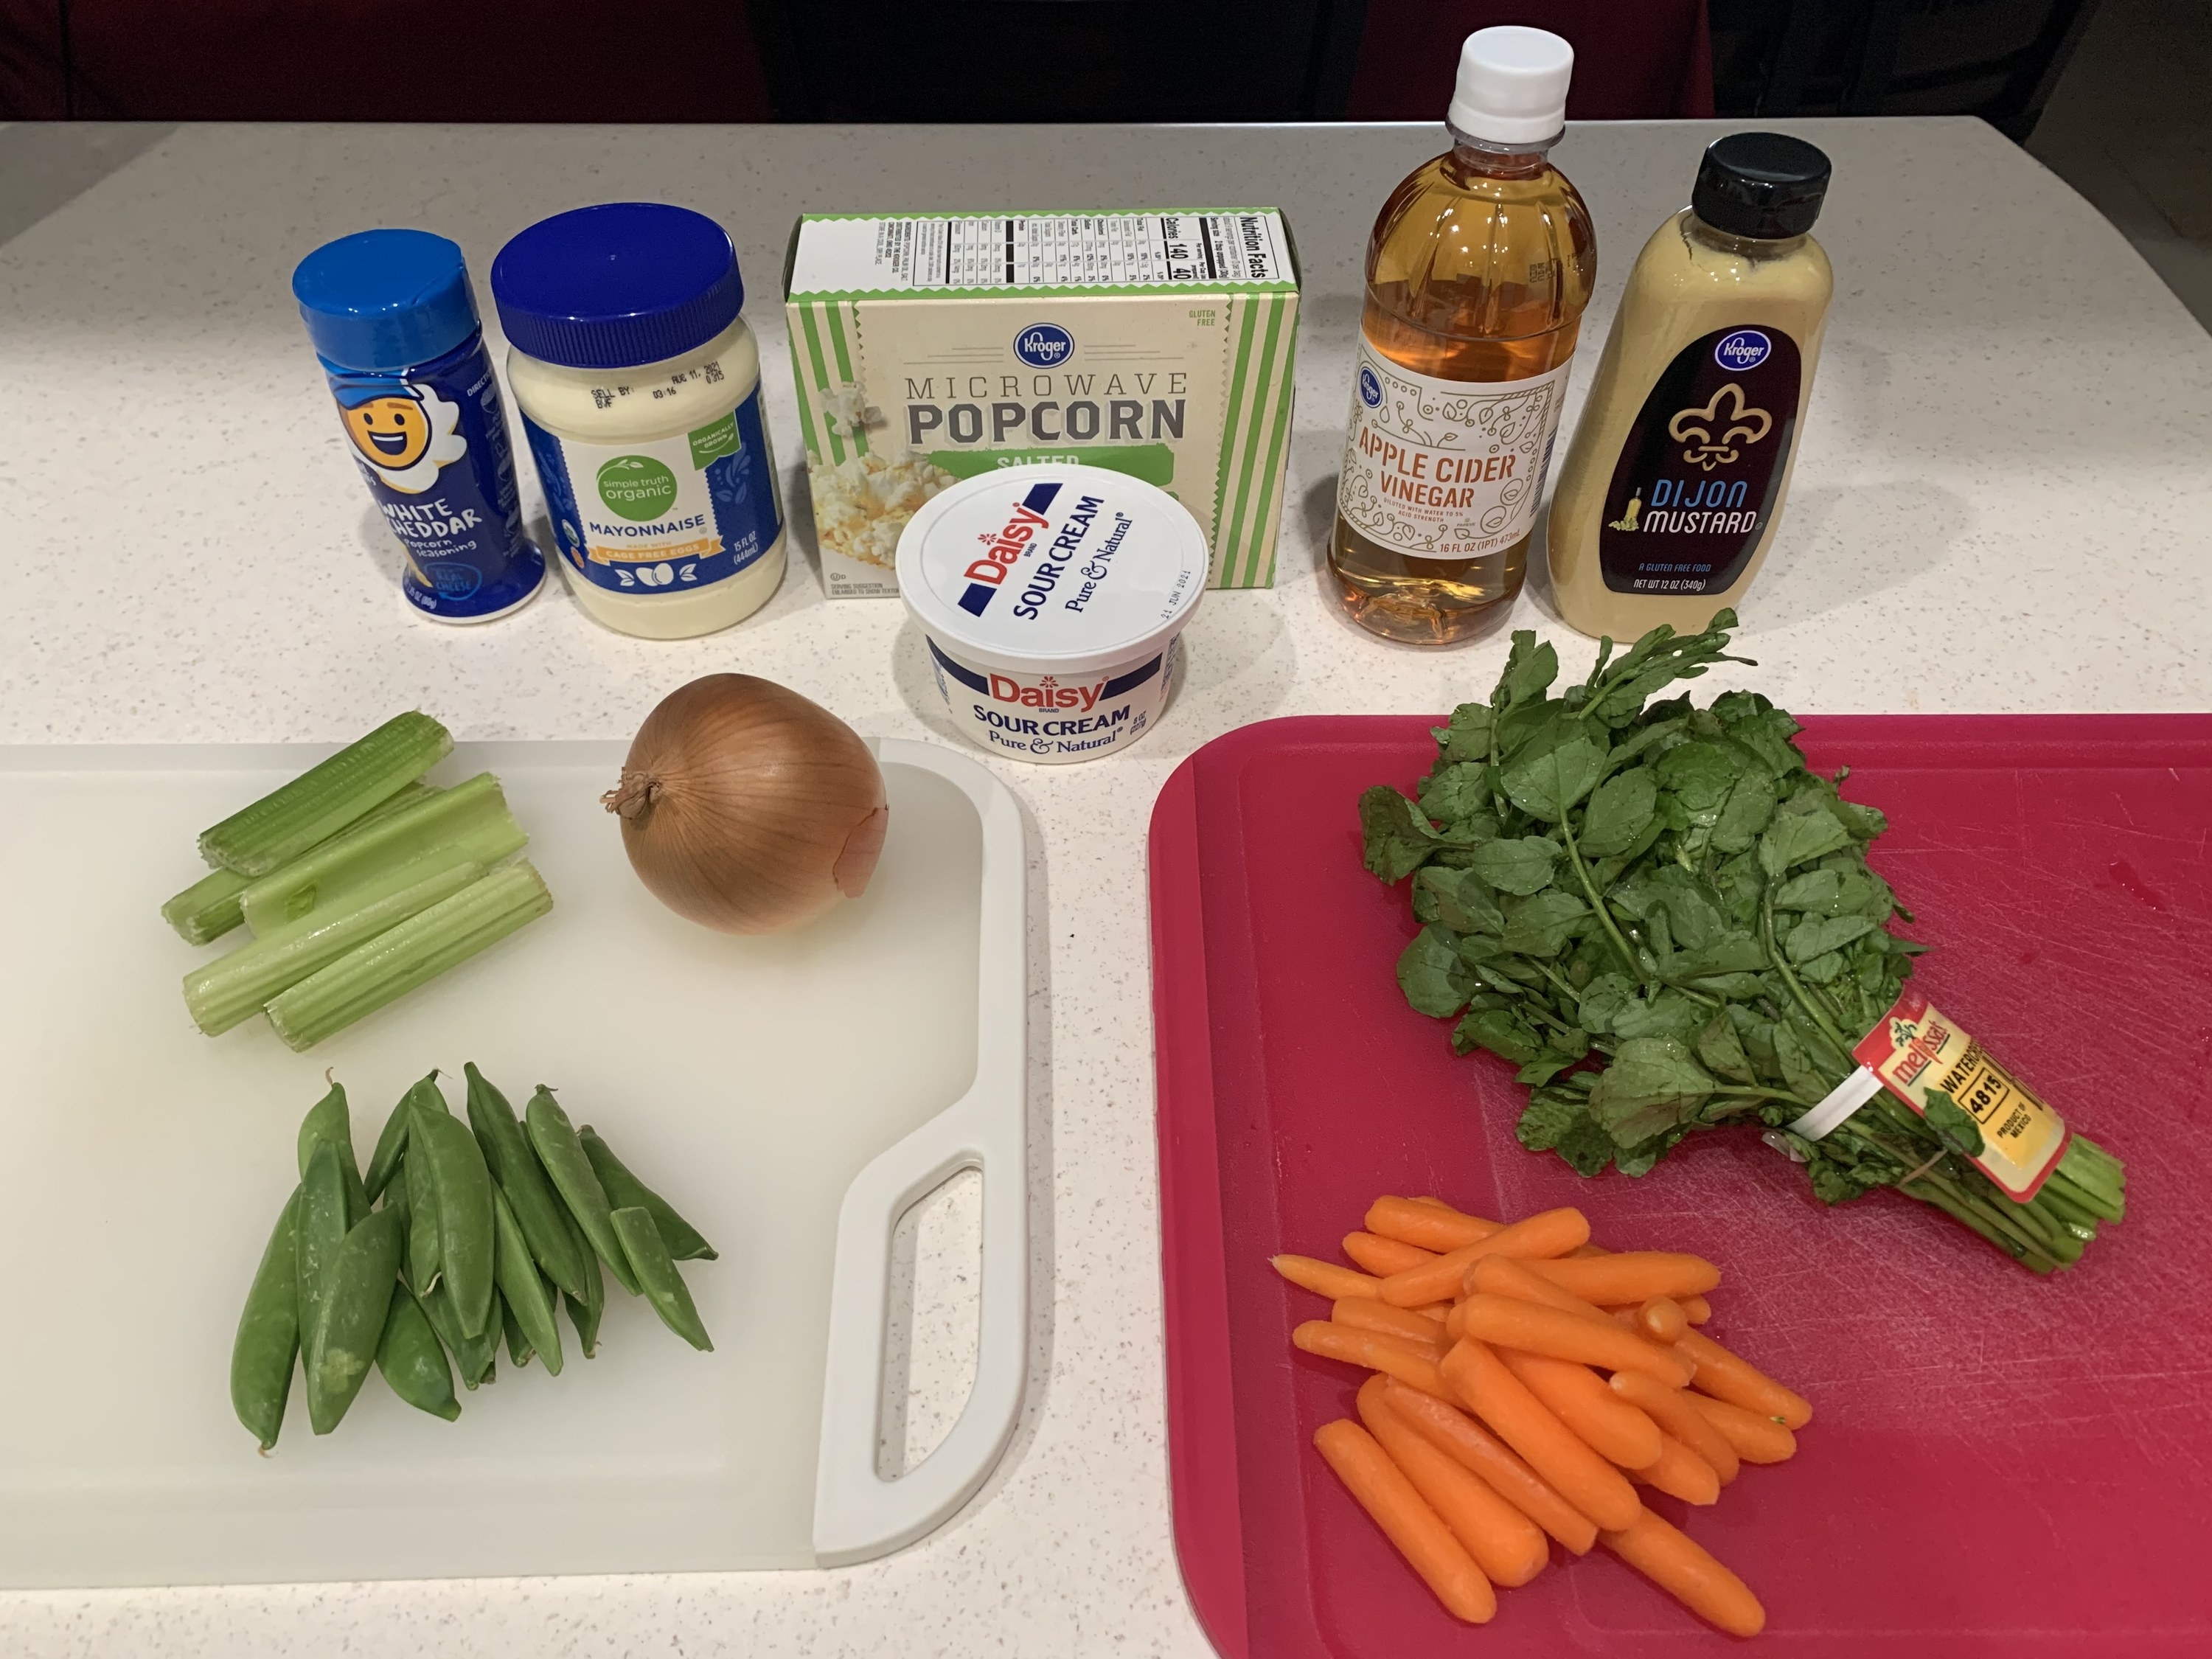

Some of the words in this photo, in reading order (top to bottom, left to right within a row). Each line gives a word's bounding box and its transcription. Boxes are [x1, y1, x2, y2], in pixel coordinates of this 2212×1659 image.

[1166, 218, 1180, 239] Calories
[1239, 217, 1263, 251] Nutrition
[1169, 243, 1189, 259] 140
[1173, 268, 1192, 279] 40
[1248, 254, 1268, 279] Facts
[1189, 310, 1216, 318] GLUTEN
[1024, 332, 1066, 361] Kroger
[1723, 337, 1764, 364] Kroger
[591, 389, 616, 399] SELL
[672, 375, 686, 385] AUG
[704, 361, 720, 375] 2021
[905, 372, 1187, 400] MICROWAVE
[1362, 373, 1379, 400] Kroger
[692, 422, 734, 446] ORGANICALLY
[906, 399, 1186, 445] POPCORN
[704, 434, 728, 448] GROWN
[1359, 426, 1428, 480] APPLE
[1436, 454, 1516, 484] CIDER
[603, 479, 639, 489] simple
[641, 475, 669, 487] truth
[605, 484, 672, 501] organic
[1380, 470, 1475, 509] VINEGAR
[1651, 479, 1747, 508] DIJON
[378, 498, 453, 521] WHITE
[1383, 497, 1405, 509] DILUTED
[386, 508, 482, 538] CHEDDAR
[589, 514, 706, 537] MAYONNAISE
[1643, 511, 1757, 534] MUSTARD
[416, 540, 477, 557] seasoning
[605, 551, 636, 559] CAGE
[638, 550, 667, 559] FREE
[669, 544, 699, 555] EGGS
[734, 540, 741, 552] 15
[742, 537, 749, 548] FL
[748, 530, 757, 543] OZ
[963, 507, 1050, 585] Daisy
[1023, 543, 1037, 557] BRAND
[1093, 517, 1133, 563] Natural
[1440, 543, 1450, 553] 16
[1452, 543, 1461, 552] FL
[1464, 542, 1476, 552] OZ
[1478, 538, 1498, 552] (1PT)
[1499, 529, 1523, 544] 473mL
[734, 542, 759, 566] (444mL)
[1013, 563, 1065, 619] SOUR
[1048, 495, 1105, 562] CREAM
[1080, 560, 1107, 580] &
[1638, 563, 1644, 571] A
[1646, 563, 1672, 572] GLUTEN
[1674, 563, 1691, 572] FREE
[1692, 563, 1711, 572] FOOD
[1065, 581, 1096, 613] Pure
[1161, 609, 1172, 619] 21
[1169, 591, 1181, 605] JUN
[1177, 570, 1191, 588] 2021
[1633, 579, 1646, 588] NET
[1648, 580, 1660, 588] WT
[1661, 580, 1669, 588] 12
[1669, 580, 1680, 589] OZ
[1680, 580, 1706, 591] (340g)
[990, 672, 1105, 713] Daisy
[973, 705, 1040, 735] SOUR
[1043, 705, 1130, 736] CREAM
[989, 730, 1027, 751] Pure
[1030, 738, 1054, 755] &
[1057, 729, 1116, 753] Natural
[1969, 1076, 2002, 1114] 4815
[1997, 1108, 2023, 1139] PRODUCT
[2010, 1113, 2031, 1139] MEXICO
